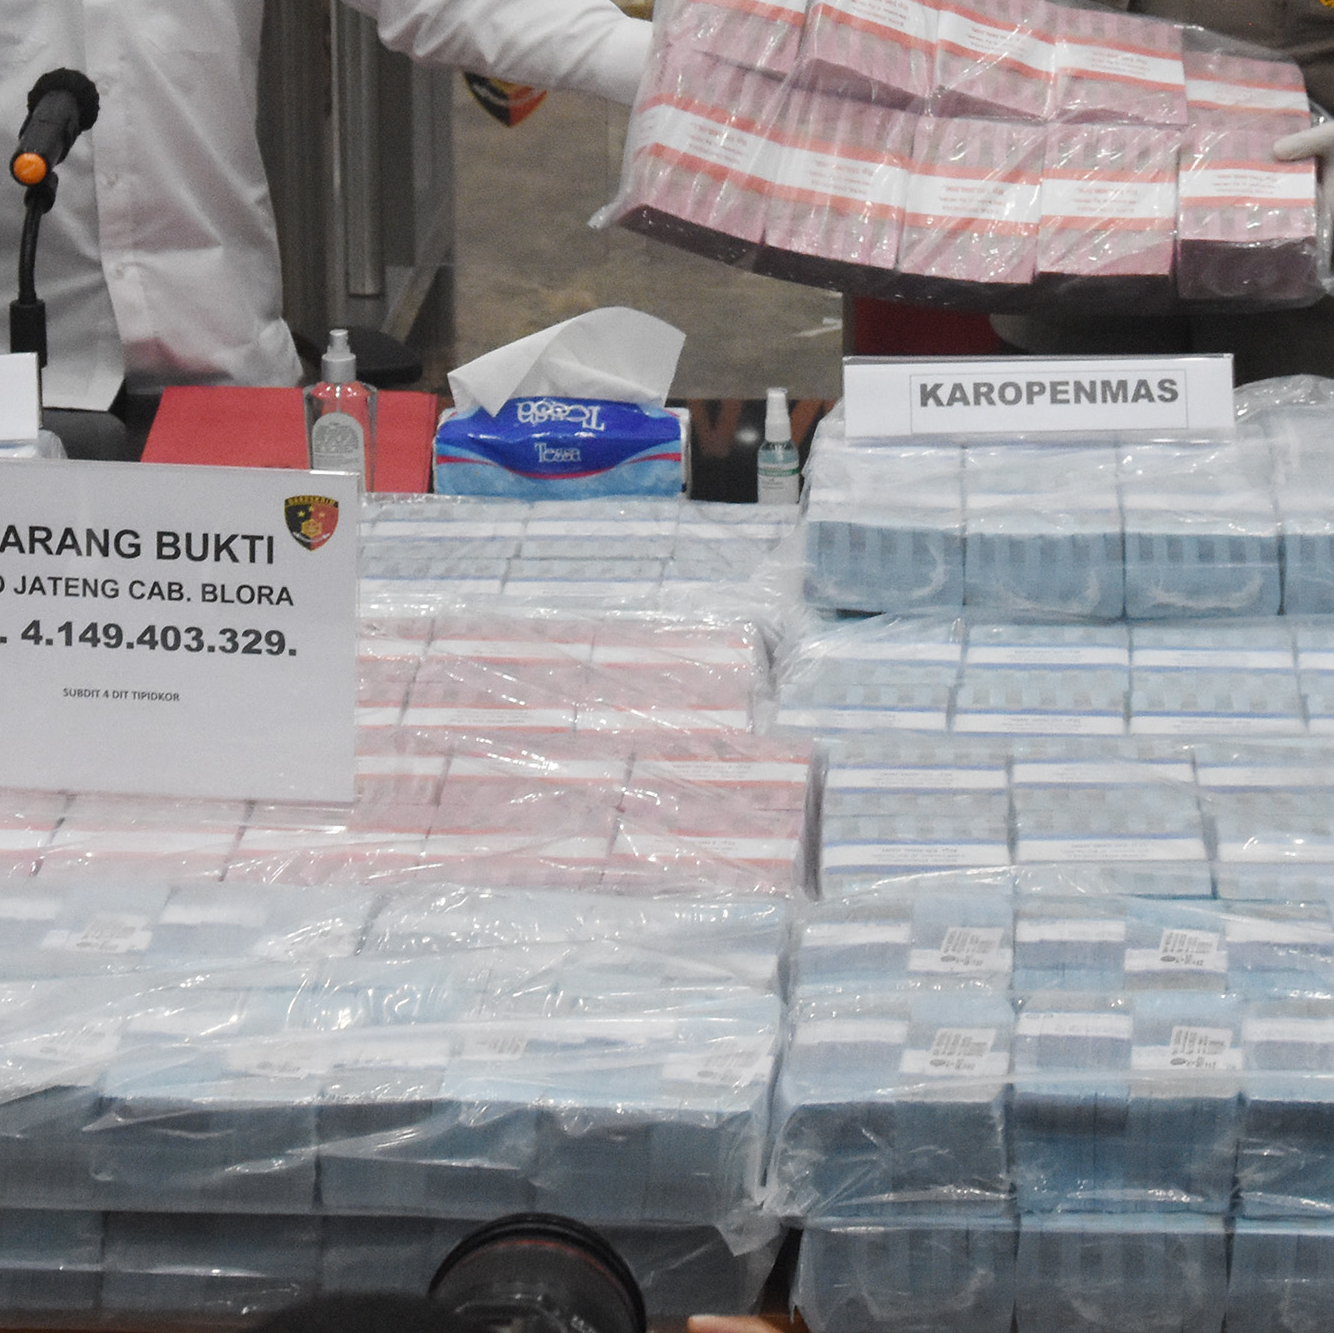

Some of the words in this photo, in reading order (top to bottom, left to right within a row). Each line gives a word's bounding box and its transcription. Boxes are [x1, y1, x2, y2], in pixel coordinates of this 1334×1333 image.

[919, 378, 1180, 408] KAROPENMAS
[516, 399, 605, 431] Tessa
[534, 442, 582, 463] Tessa
[155, 530, 275, 566] BUKTI
[12, 574, 121, 600] JATENG
[127, 578, 193, 603] CAB.
[200, 582, 295, 608] BLORA
[19, 618, 298, 657] 4.149.403.329.
[64, 688, 100, 698] SUBDIT
[103, 690, 109, 699] 4
[113, 690, 129, 699] DIT
[132, 691, 180, 701] TIPIDKOR
